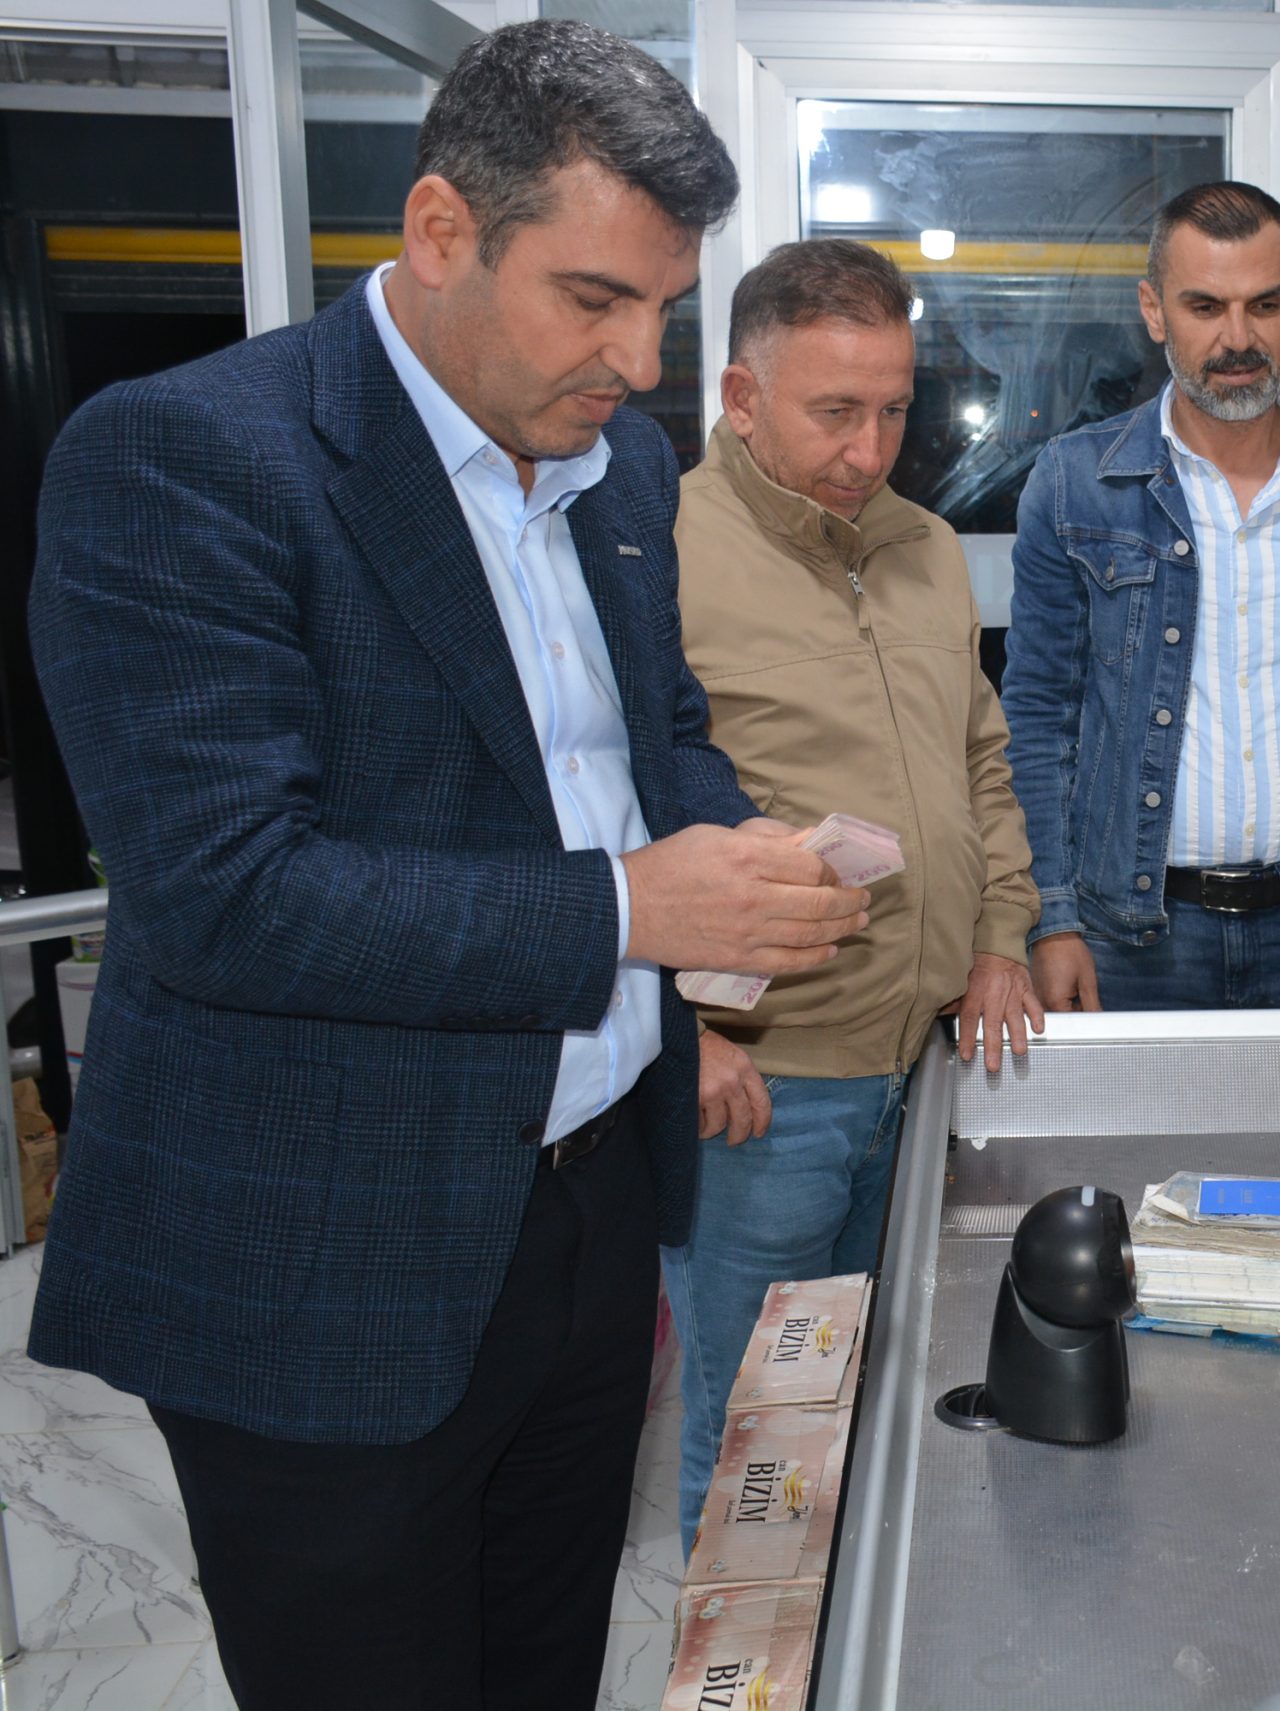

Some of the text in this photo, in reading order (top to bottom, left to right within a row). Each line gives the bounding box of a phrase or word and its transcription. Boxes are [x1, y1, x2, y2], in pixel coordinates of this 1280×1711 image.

[852, 864, 892, 883] 200
[773, 1317, 814, 1362] BİZİM
[778, 1460, 787, 1472] can
[736, 1460, 782, 1524] BİZİM
[742, 1658, 754, 1675] can
